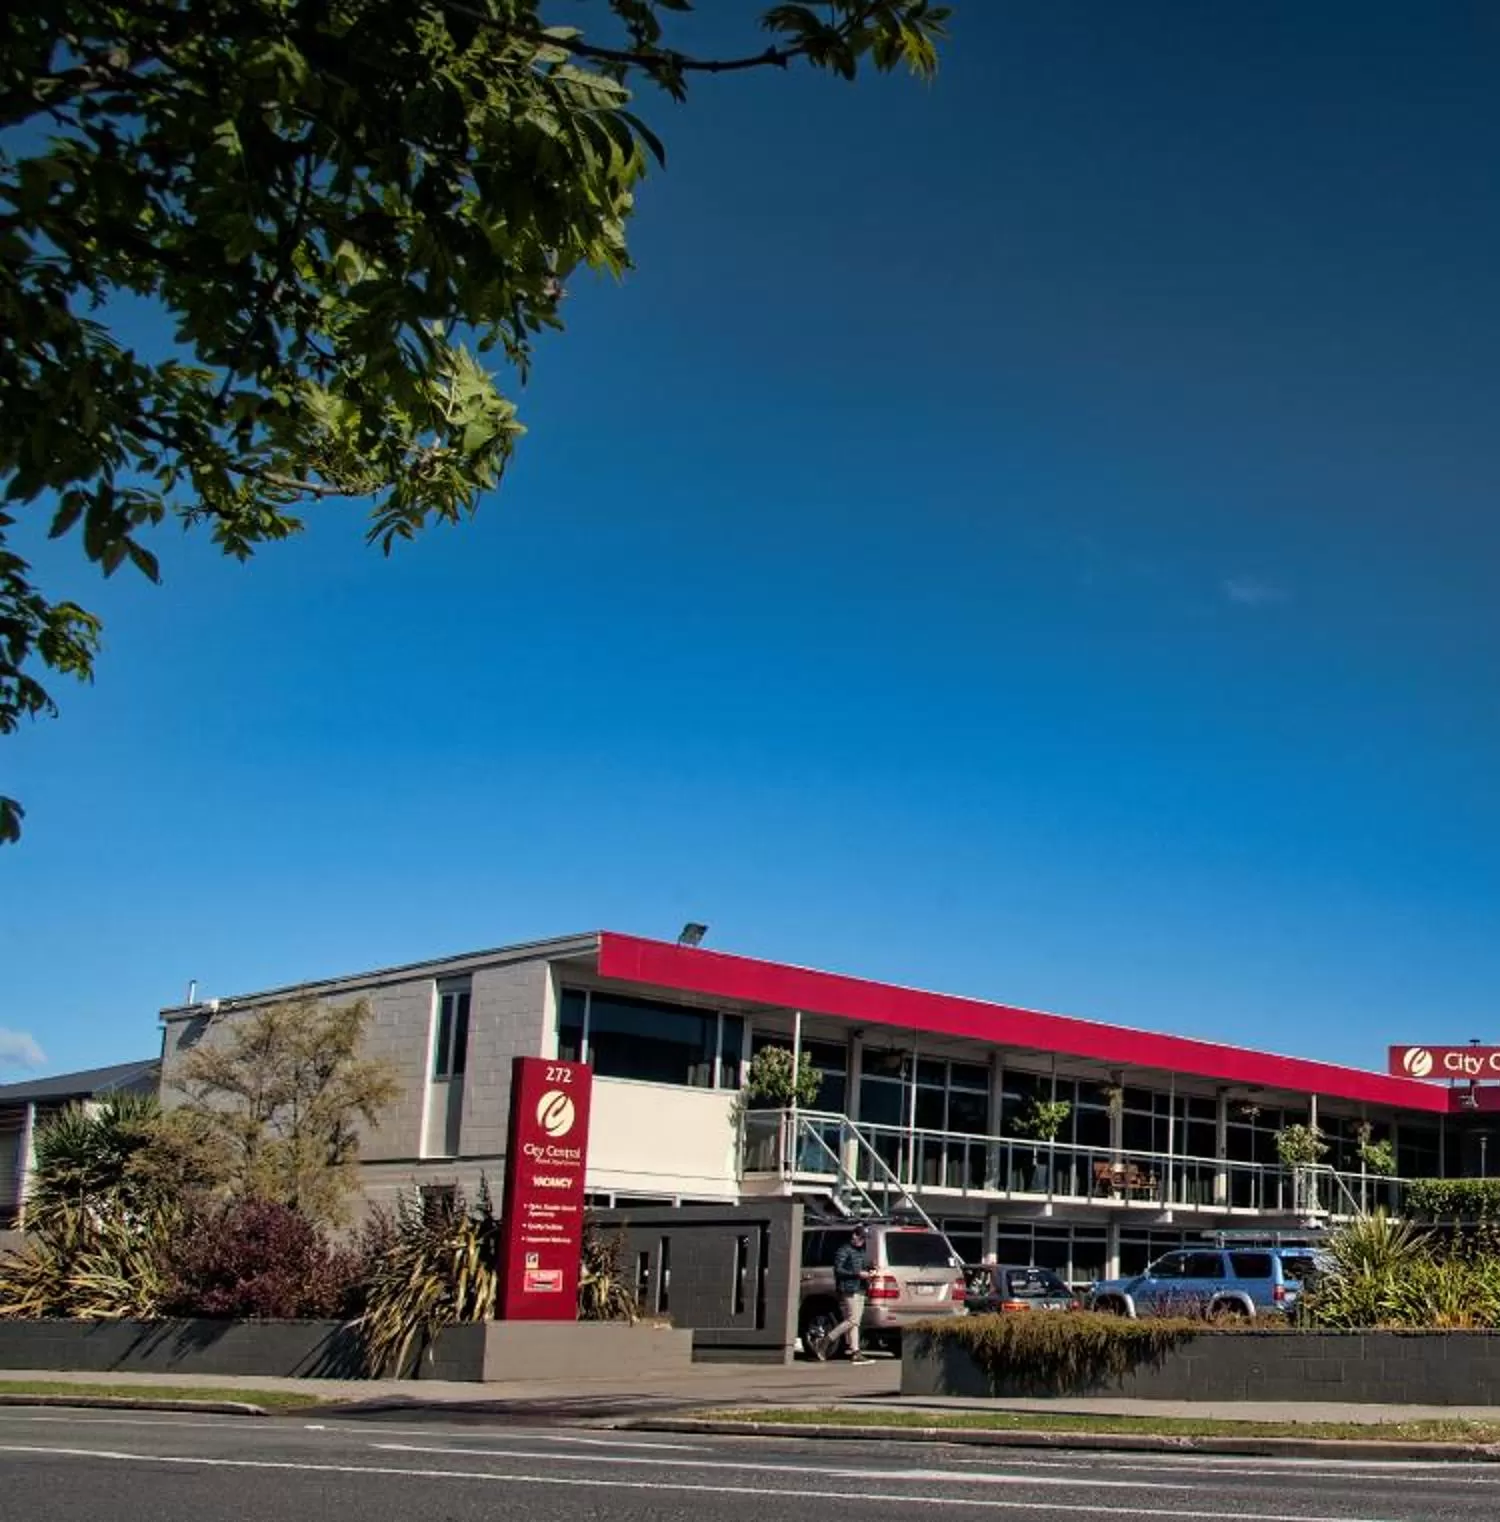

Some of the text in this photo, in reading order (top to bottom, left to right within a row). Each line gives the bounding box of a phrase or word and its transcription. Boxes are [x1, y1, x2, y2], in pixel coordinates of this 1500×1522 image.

[1444, 1052, 1484, 1074] City
[545, 1066, 572, 1083] 272
[523, 1143, 580, 1161] City Central
[532, 1175, 573, 1189] VACANCY
